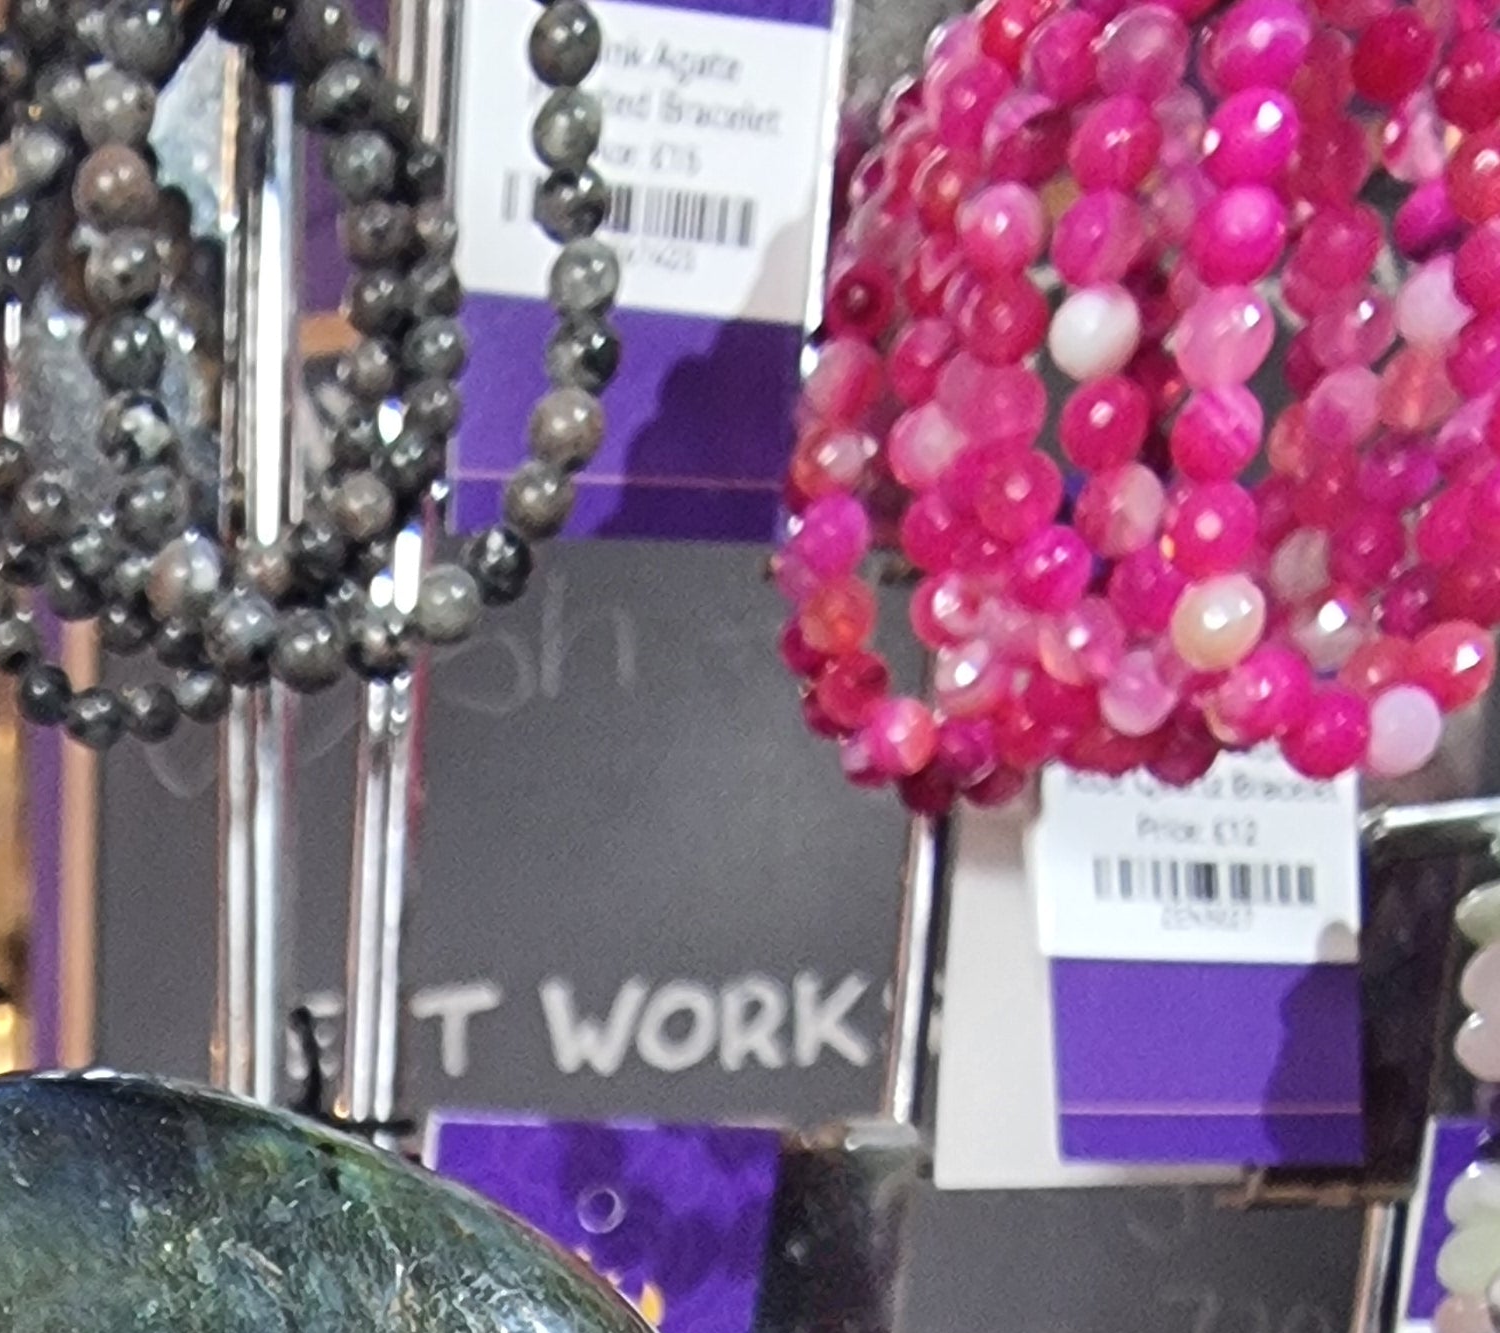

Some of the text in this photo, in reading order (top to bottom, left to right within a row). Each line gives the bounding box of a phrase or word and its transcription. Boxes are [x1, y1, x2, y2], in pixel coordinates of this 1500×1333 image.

[657, 40, 742, 84] Agate
[659, 90, 783, 136] Bracelet
[1137, 812, 1198, 843] Price:
